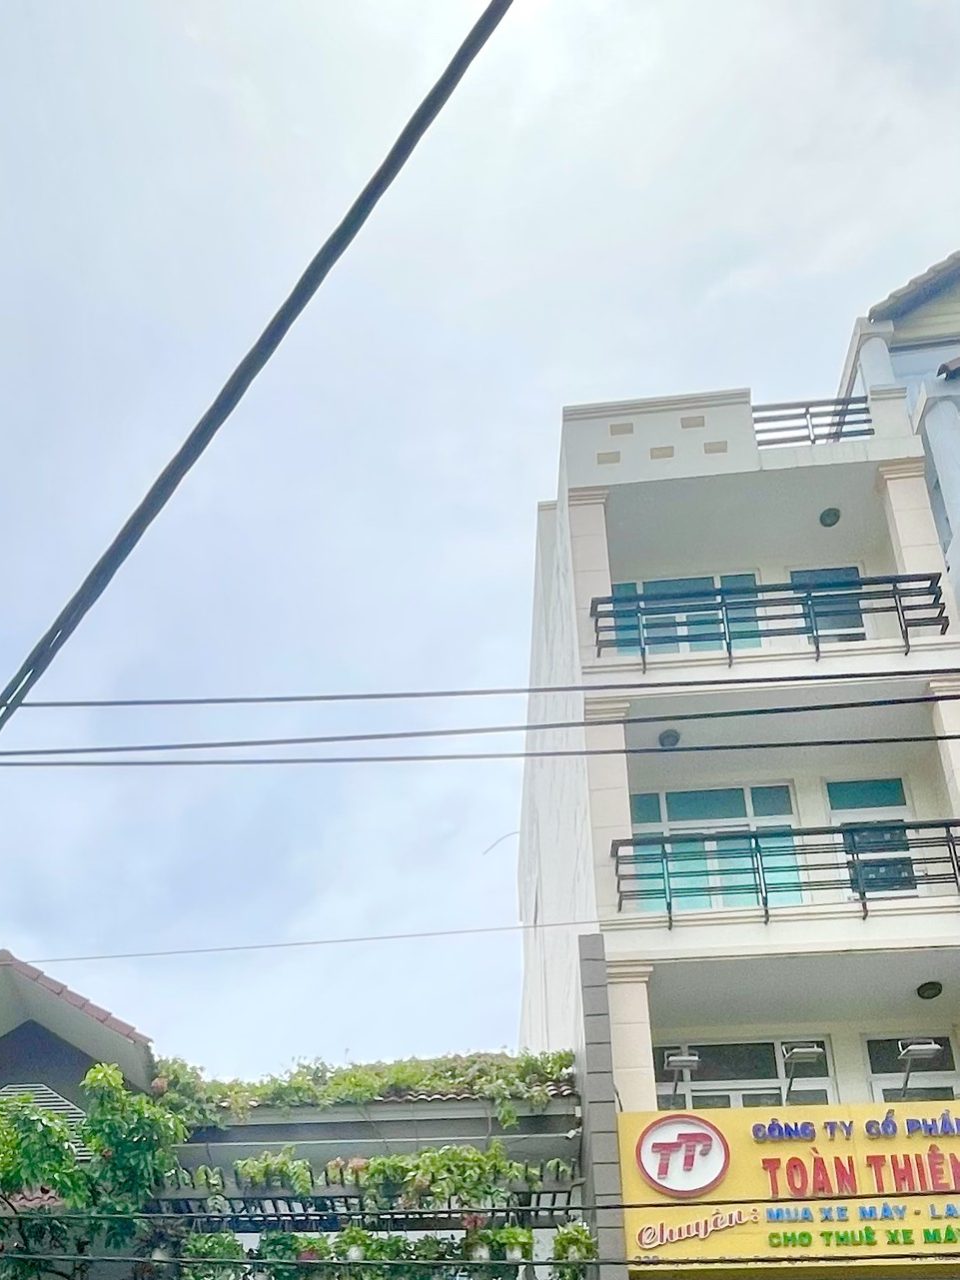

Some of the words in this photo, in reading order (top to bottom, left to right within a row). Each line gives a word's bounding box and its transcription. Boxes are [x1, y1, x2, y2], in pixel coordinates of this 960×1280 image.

[824, 1121, 854, 1140] TY
[761, 1147, 858, 1198] TOÀN
[766, 1207, 813, 1222] MUA
[820, 1206, 848, 1221] XE
[768, 1231, 812, 1248] CHO
[886, 1229, 914, 1245] XE
[923, 1225, 960, 1244] MÁ
